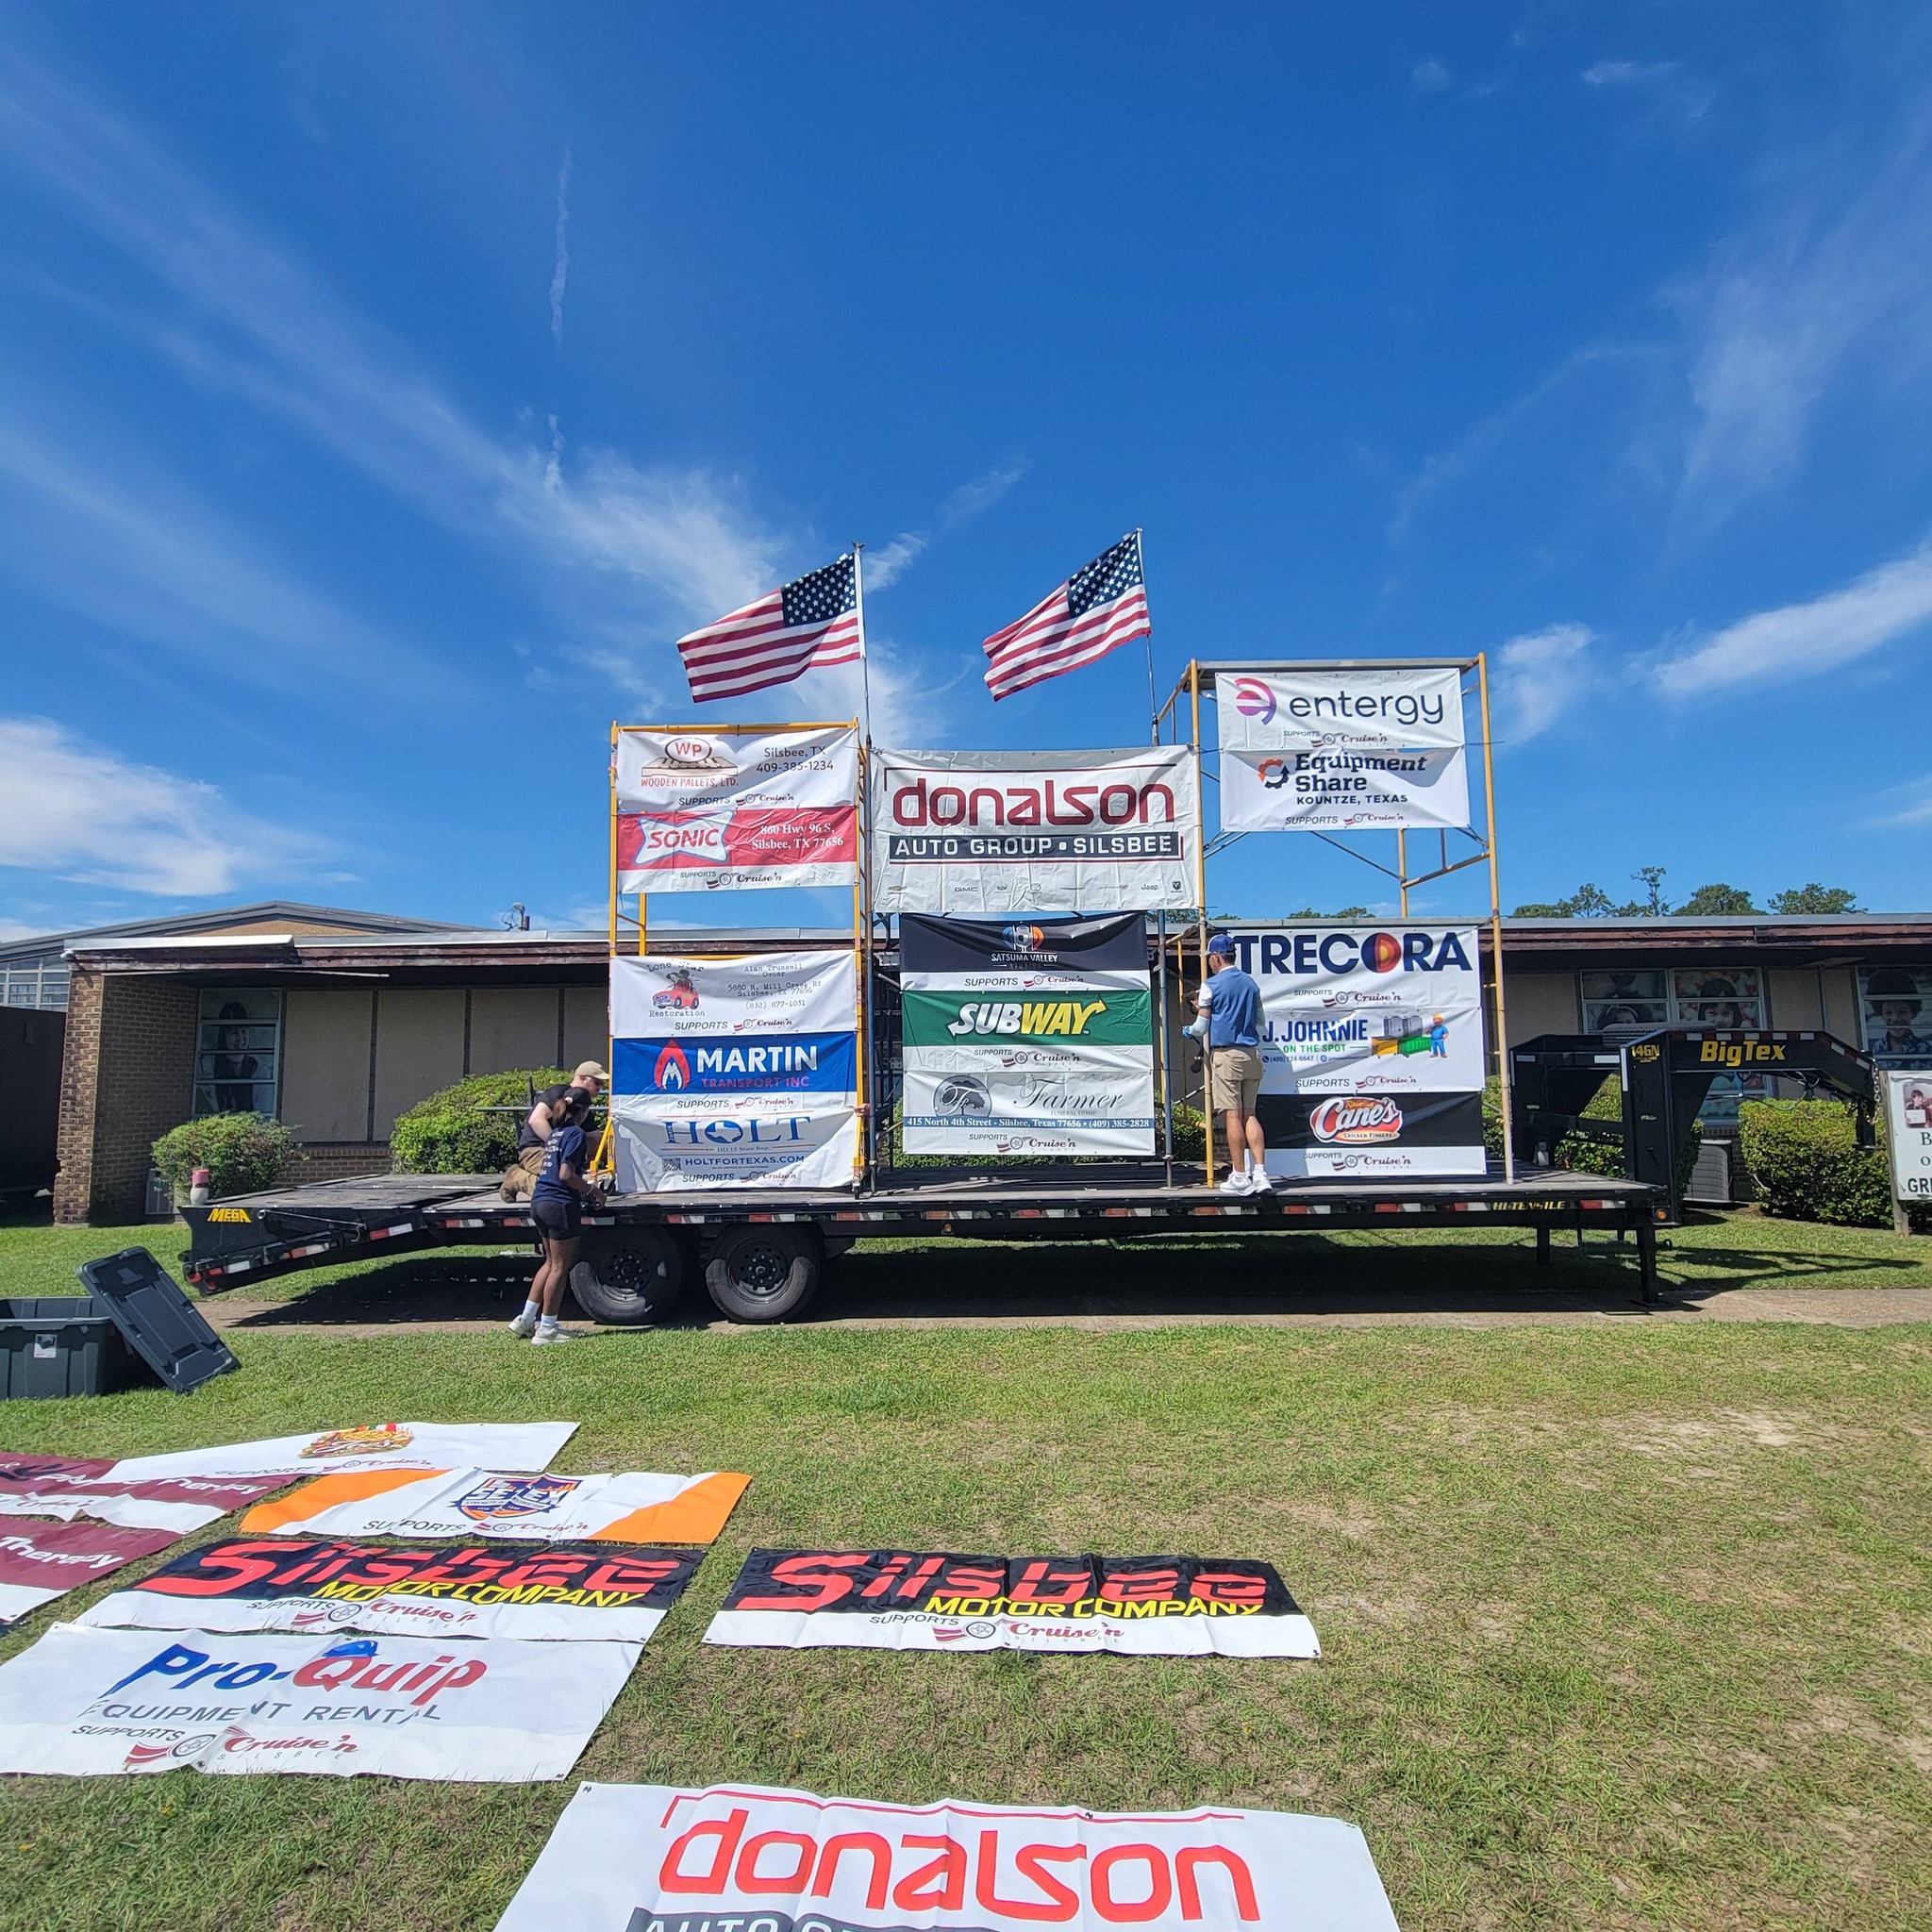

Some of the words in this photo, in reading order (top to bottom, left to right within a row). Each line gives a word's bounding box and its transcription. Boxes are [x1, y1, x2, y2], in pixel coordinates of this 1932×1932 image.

[1290, 691, 1444, 724] entergy
[675, 741, 702, 757] WP
[764, 747, 808, 758] Silsbee,
[810, 746, 826, 756] TX
[757, 760, 834, 773] 409-385-1234
[1295, 753, 1427, 772] Equipment
[641, 776, 677, 788] WOODEN
[680, 777, 718, 788] PALLETS,
[721, 776, 739, 787] LTD.
[1295, 774, 1368, 792] Share
[678, 796, 731, 806] SUPPORTS
[892, 777, 1174, 826] donalson
[1296, 795, 1361, 806] KOUNTZE,
[1365, 794, 1407, 804] TEXAS
[1285, 815, 1339, 825] SUPPORTS
[782, 824, 807, 836] Hwy
[808, 823, 822, 833] 96
[824, 823, 835, 834] S,
[648, 828, 720, 849] SONIC
[751, 839, 791, 850] Silsbee,
[792, 838, 810, 849] TX
[813, 836, 844, 848] 77656
[895, 838, 959, 856] AUTO
[970, 837, 1052, 856] GROUP
[1074, 835, 1172, 855] SILSBEE
[991, 953, 1029, 962] SATSUMA
[1029, 954, 1058, 962] VALLEY
[1233, 932, 1473, 974] TRECORA
[646, 962, 672, 973] Lone
[965, 977, 1018, 987] SUPPORTS
[675, 1021, 728, 1031] SUPPORTS
[948, 1000, 1106, 1037] SUBWAY
[1283, 1044, 1296, 1054] ON
[1299, 1044, 1320, 1053] THE
[1322, 1043, 1346, 1053] SPOT
[697, 1045, 817, 1073] MARTIN
[701, 1076, 779, 1089] TRANSPORT
[1295, 1078, 1350, 1088] SUPPORTS
[1013, 1075, 1124, 1109] Farmer
[677, 1100, 730, 1108] SUPPORTS
[907, 1117, 923, 1126] 415
[924, 1117, 949, 1126] North
[951, 1117, 965, 1126] 4th
[966, 1118, 991, 1126] Street
[999, 1119, 1031, 1127] Silsbee,
[1032, 1119, 1056, 1127] Texas
[1089, 1119, 1110, 1128] (409)
[1315, 1097, 1400, 1139] Cane's
[660, 1117, 811, 1144] HOLT
[685, 1156, 805, 1166] HOLTFORTEXAS.COM
[1364, 1155, 1411, 1165] Cruise'n
[682, 1173, 735, 1183] SUPPORTS
[1907, 1178, 1932, 1193] GR
[207, 1208, 252, 1223] MEGA
[133, 1541, 680, 1596] Silsbee
[736, 1556, 1266, 1610] Silsbee
[457, 1582, 647, 1607] COMPANY
[246, 1599, 336, 1610] SUPPORTS
[924, 1596, 1063, 1617] MOTOR
[1074, 1596, 1266, 1618] COMPANY
[869, 1614, 959, 1625] SUPPORTS
[1009, 1621, 1125, 1638] Cruise'n
[97, 1641, 487, 1707] Pro-Quip
[303, 1704, 441, 1725] RENTAL
[72, 1724, 186, 1741] SUPPORTS
[225, 1734, 359, 1754] Cruise'n
[217, 1750, 342, 1760] SILSBEE
[659, 1808, 1259, 1923] donalson
